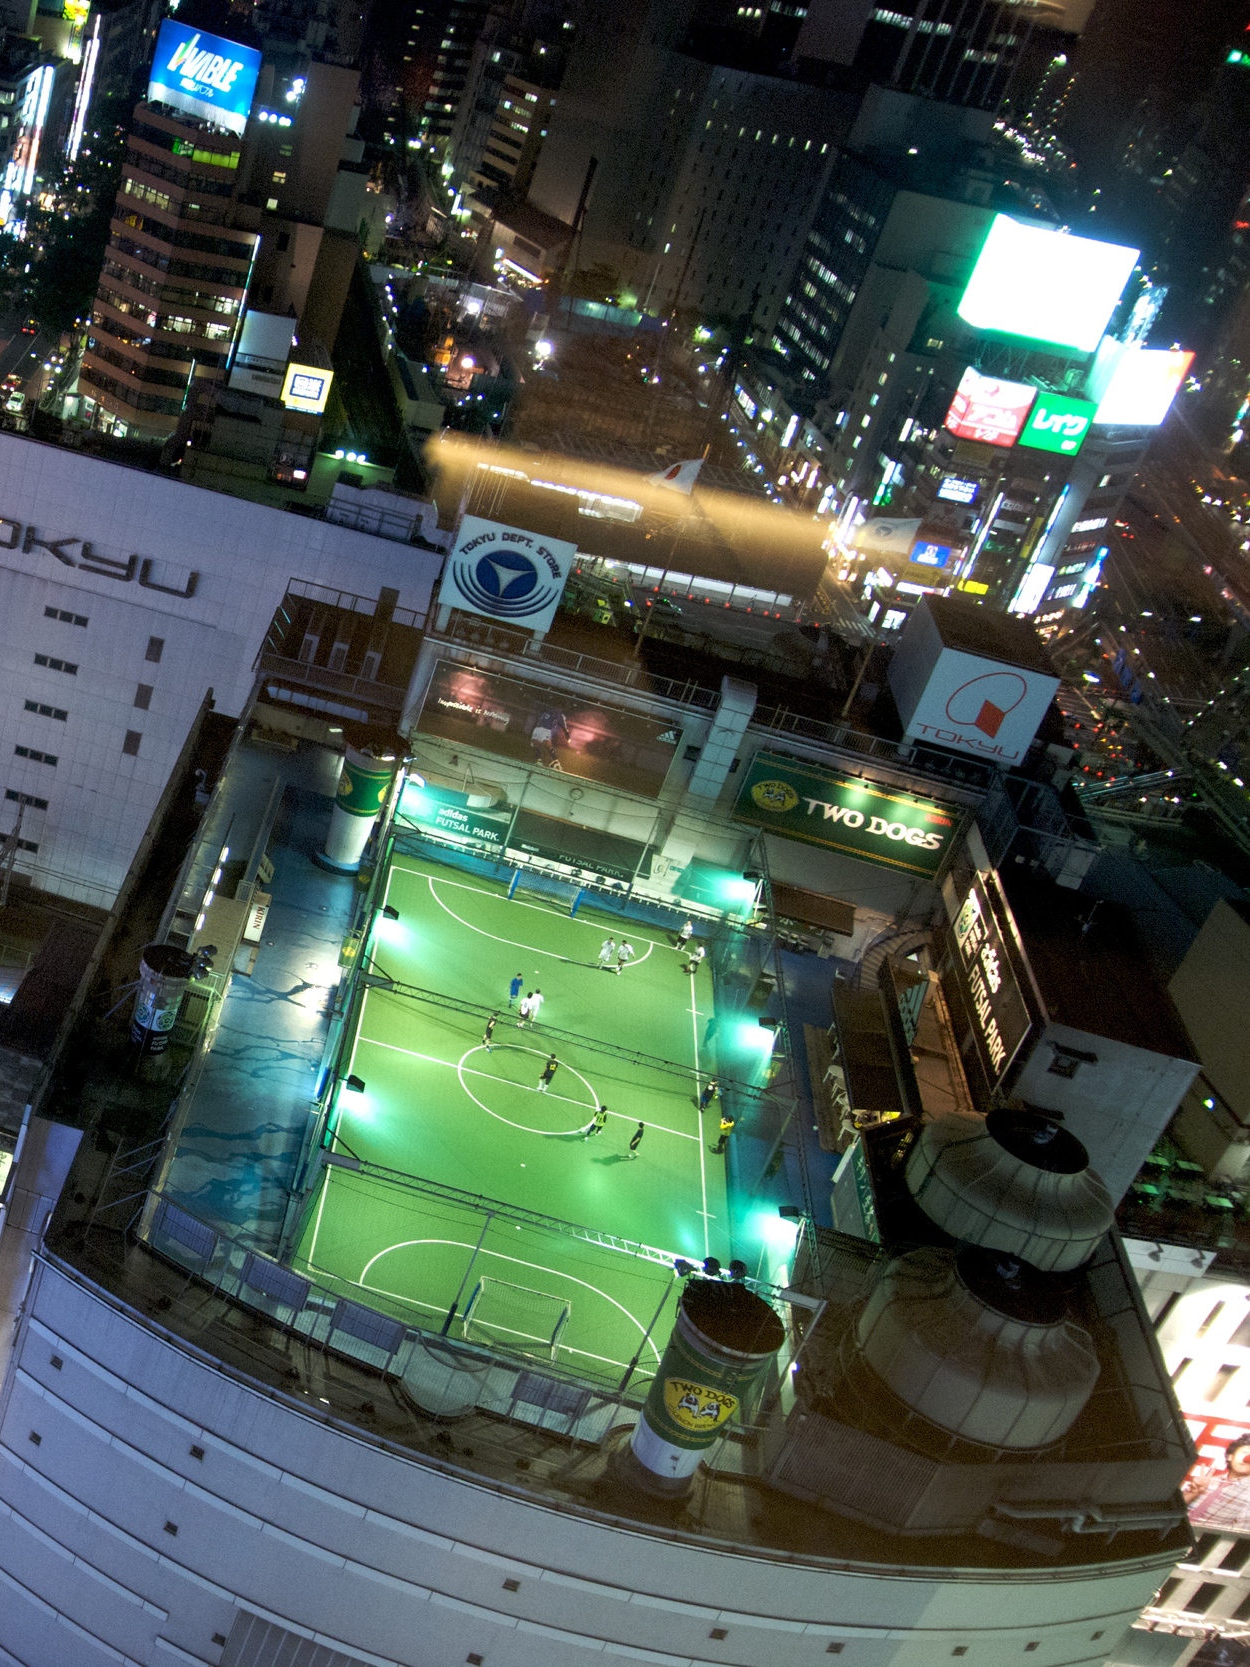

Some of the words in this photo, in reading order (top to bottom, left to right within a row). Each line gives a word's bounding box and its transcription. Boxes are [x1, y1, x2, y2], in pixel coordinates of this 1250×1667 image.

[1032, 408, 1088, 436] レイク
[459, 532, 496, 555] TOKYU
[502, 532, 534, 548] DEPT.
[536, 546, 561, 579] STORE
[916, 722, 1019, 760] TOKYU
[435, 817, 470, 834] FUTSAL
[438, 808, 468, 822] adidas
[802, 797, 864, 828] TWO
[865, 816, 944, 850] DOGS
[253, 906, 267, 929] KIRIN
[980, 943, 1002, 993] adidas
[968, 964, 992, 1030] FUTSAL
[670, 1381, 702, 1396] TWO
[705, 1391, 736, 1409] DOGS
